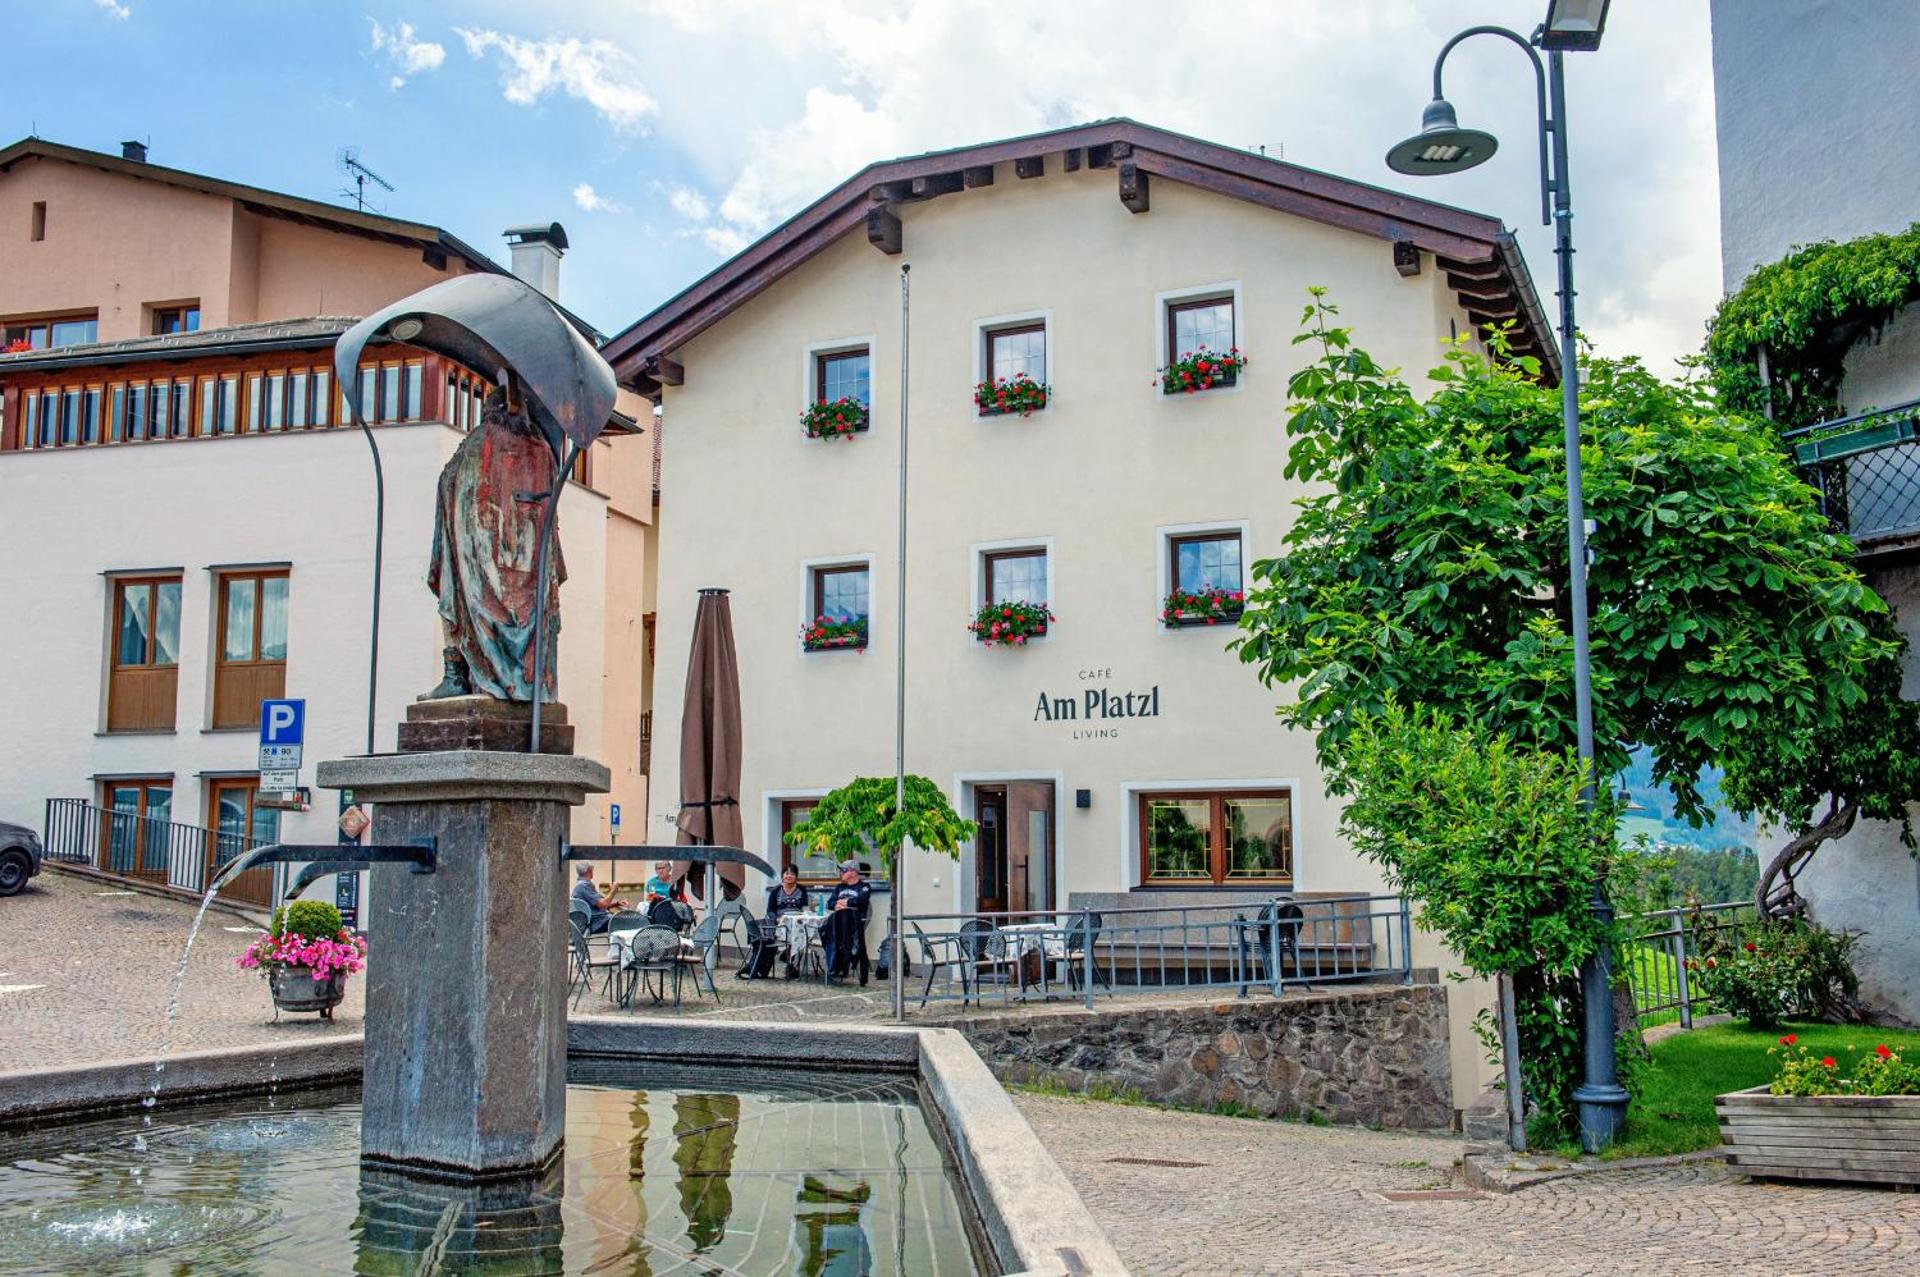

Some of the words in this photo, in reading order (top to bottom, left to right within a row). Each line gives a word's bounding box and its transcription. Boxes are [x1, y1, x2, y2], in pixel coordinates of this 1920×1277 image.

[1078, 667, 1113, 680] CAFÉ
[1034, 691, 1077, 721] Am
[1084, 685, 1160, 719] Platzl
[268, 704, 295, 741] P
[1073, 728, 1119, 740] LIVING
[612, 806, 619, 822] P
